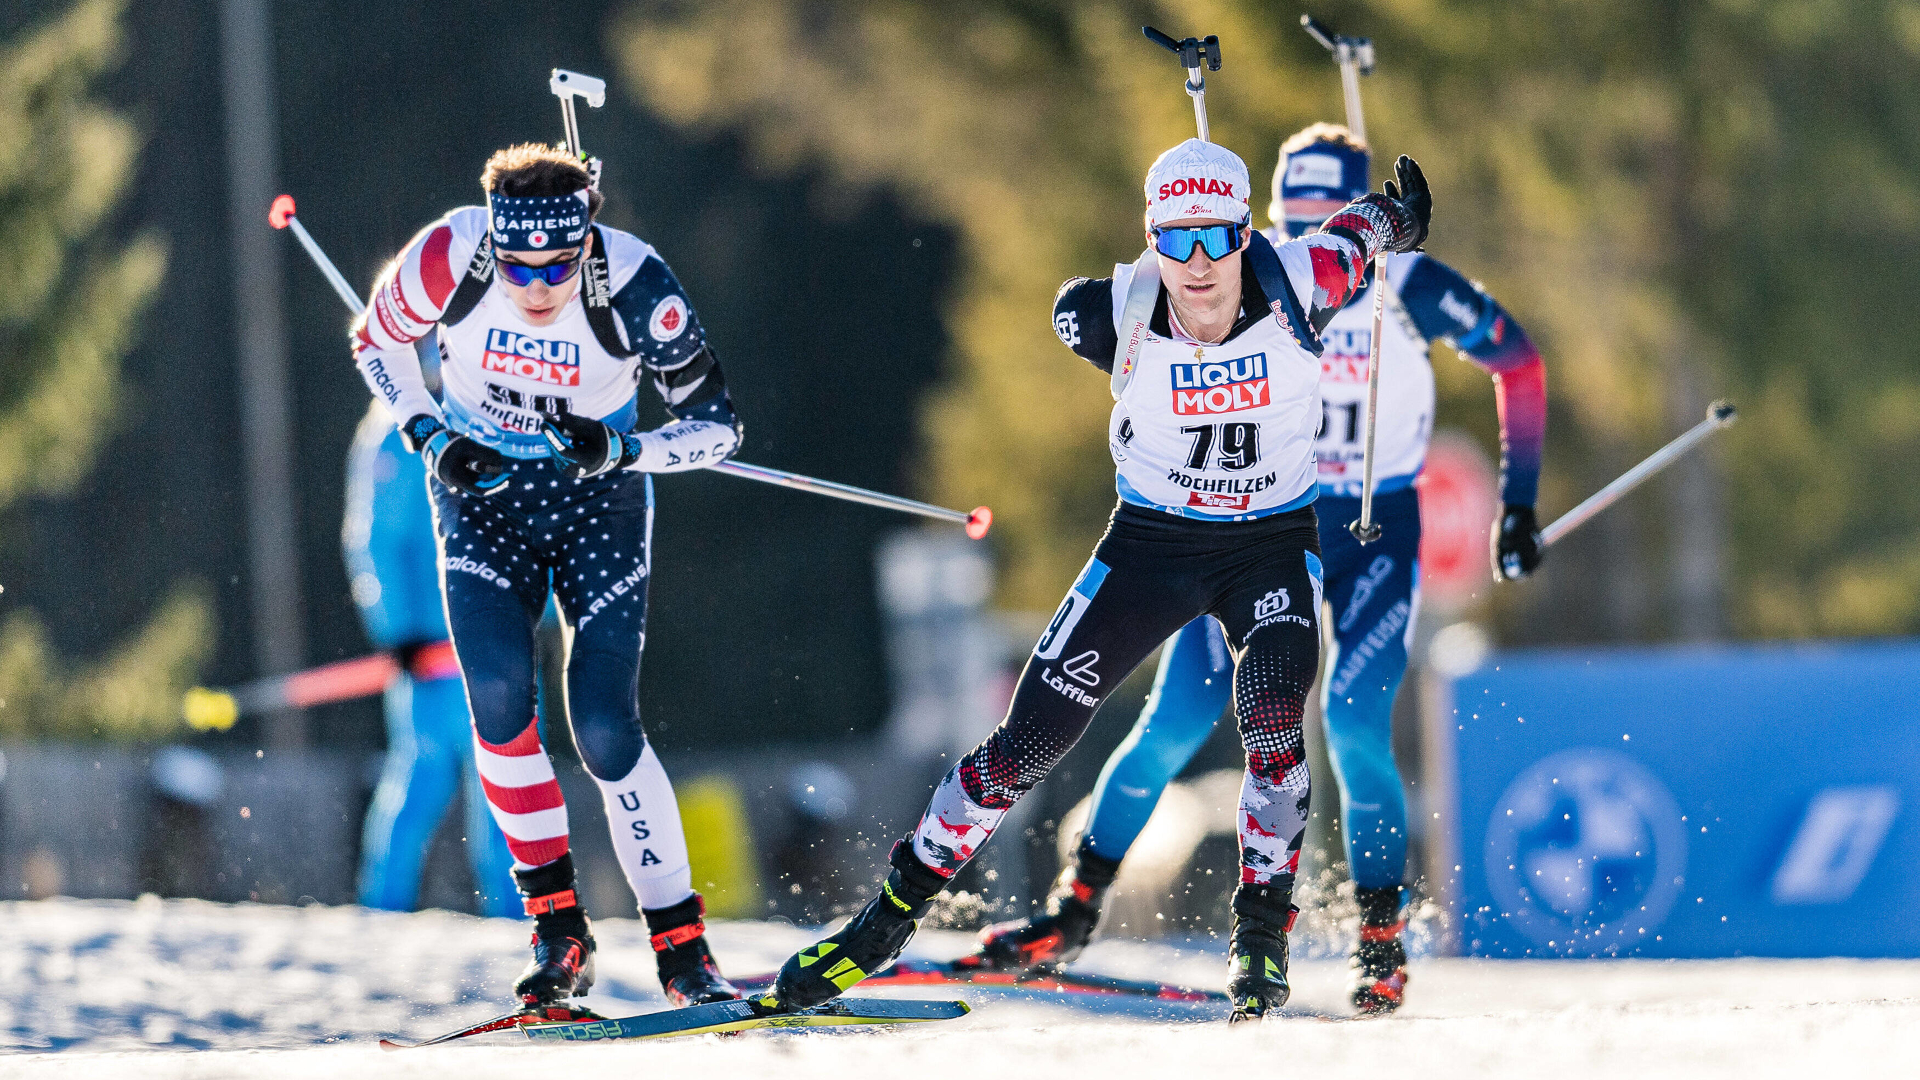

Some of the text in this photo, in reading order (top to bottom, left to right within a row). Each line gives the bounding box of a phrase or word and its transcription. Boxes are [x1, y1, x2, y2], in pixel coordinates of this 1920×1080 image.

[1158, 177, 1235, 201] SONAX
[507, 215, 581, 230] ARIENS
[489, 329, 576, 365] LIQUI
[1132, 321, 1145, 340] Red
[486, 352, 578, 386] MOLY
[1175, 355, 1264, 388] LIQUI
[1176, 380, 1268, 414] MOLY
[1180, 422, 1262, 473] 79
[1167, 468, 1277, 494] HOCHFILZEN
[1196, 493, 1243, 507] Tirol
[577, 564, 649, 632] ARIENS
[1242, 613, 1311, 644] Husqvarna
[617, 789, 663, 867] USA
